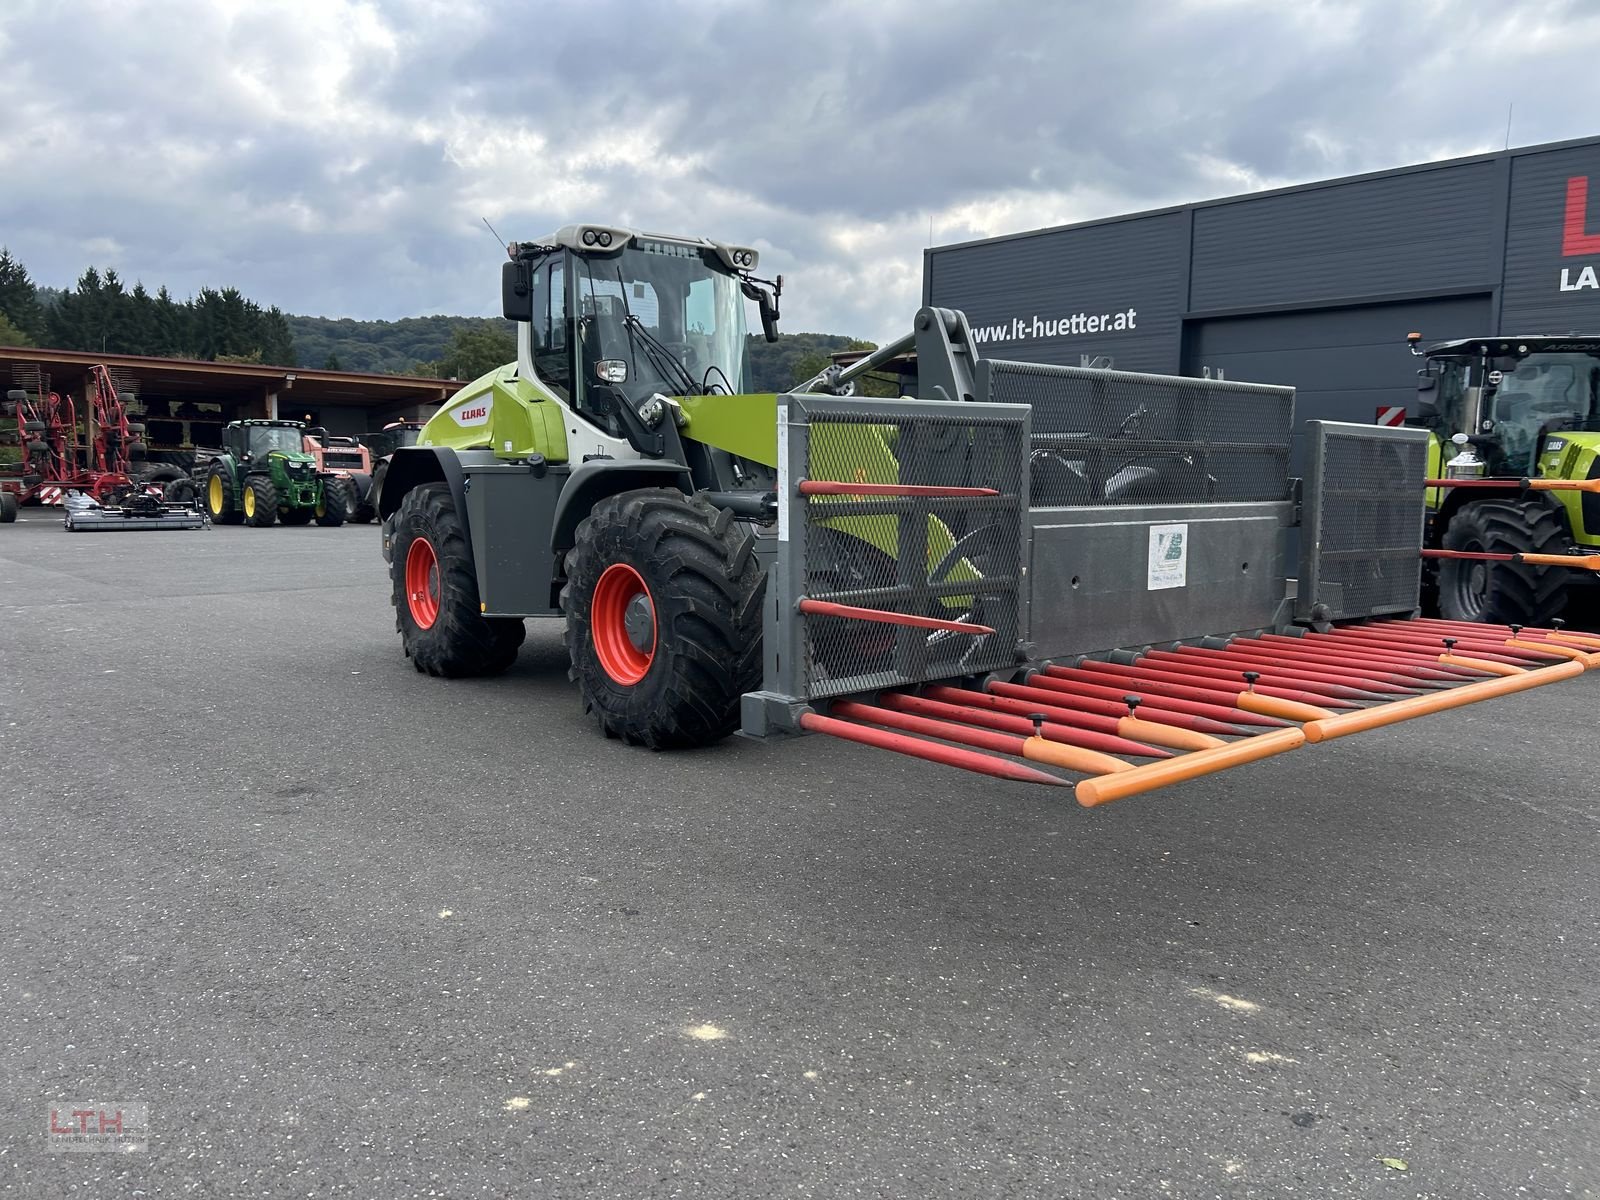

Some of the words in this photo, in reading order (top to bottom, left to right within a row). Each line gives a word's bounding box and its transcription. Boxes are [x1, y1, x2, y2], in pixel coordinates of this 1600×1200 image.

[643, 242, 701, 260] CLAAS
[969, 308, 1137, 344] ww.lt-huetter.at
[461, 407, 486, 421] CLAAS
